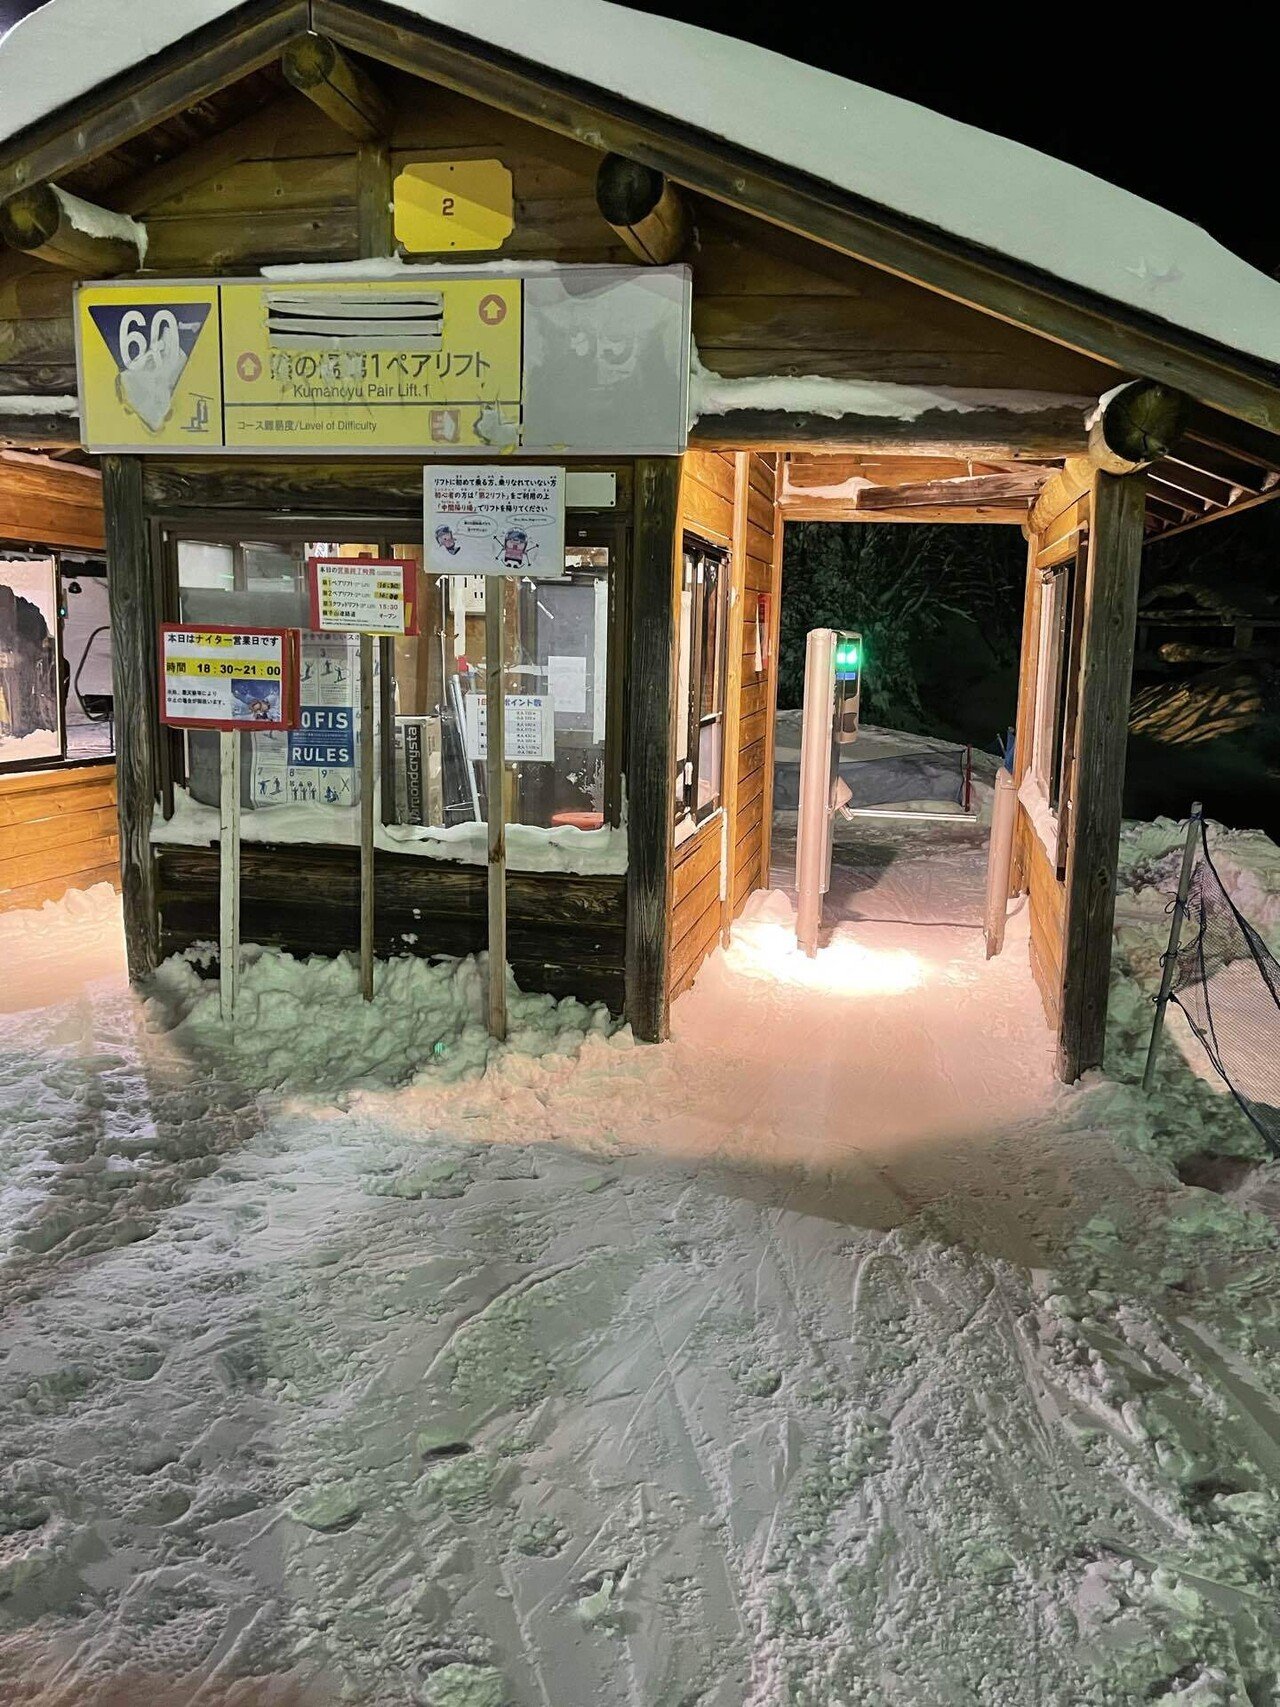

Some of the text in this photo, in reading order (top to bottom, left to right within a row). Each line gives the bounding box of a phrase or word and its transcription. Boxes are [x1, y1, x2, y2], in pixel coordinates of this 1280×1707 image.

[442, 198, 455, 216] 2
[119, 309, 180, 369] 60
[269, 352, 491, 379] の1ペアリフト
[293, 384, 363, 400] Kumanoyu
[367, 384, 394, 397] Pair
[326, 420, 335, 431] of
[338, 420, 377, 432] Difficulty
[168, 634, 279, 647] 本日はナイター営業日です
[166, 662, 187, 674] 時間
[292, 747, 349, 762] RULES
[289, 768, 295, 777] 8
[321, 769, 328, 778] 9
